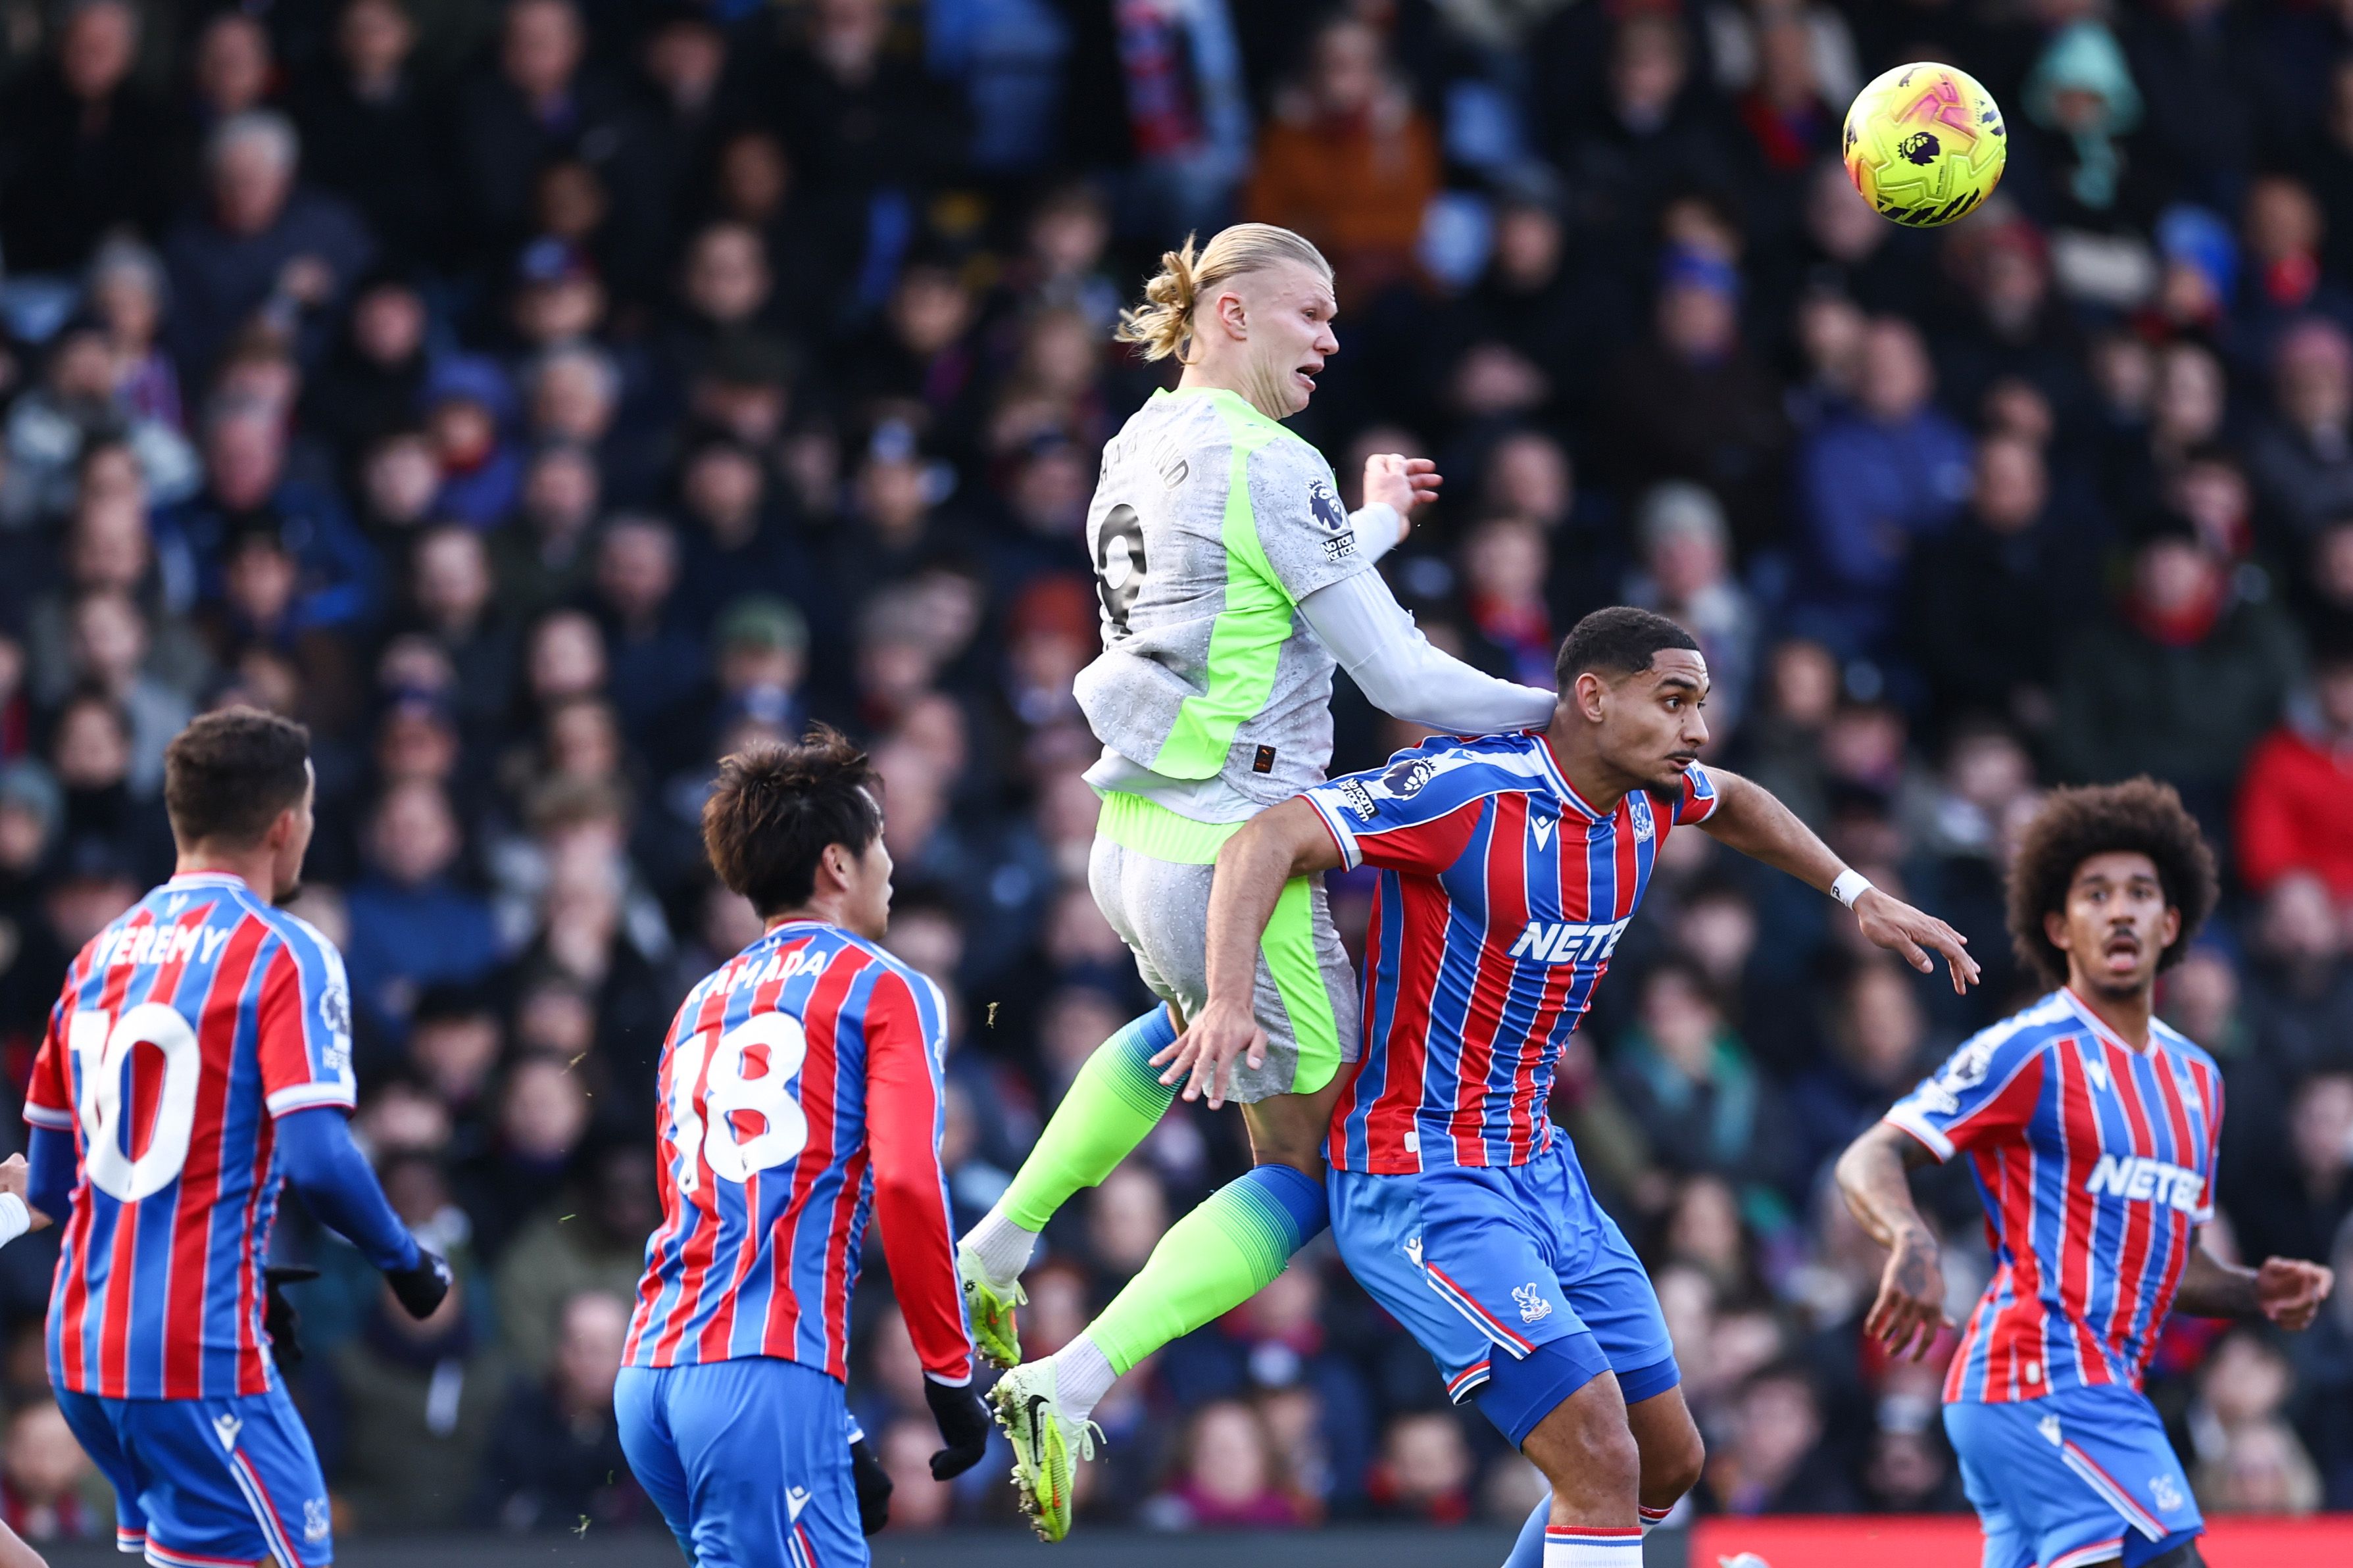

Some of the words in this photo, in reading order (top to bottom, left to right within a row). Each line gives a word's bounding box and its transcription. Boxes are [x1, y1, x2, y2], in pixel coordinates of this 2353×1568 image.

[1099, 431, 1189, 490] HAAND
[1098, 503, 1147, 640] 9
[1320, 541, 1337, 553] No
[1325, 550, 1341, 562] for
[1345, 789, 1370, 822] racism
[1347, 777, 1359, 789] No
[1353, 787, 1375, 814] room
[95, 923, 229, 968] YEREMY
[687, 950, 828, 1003] KAMADA
[68, 1002, 201, 1203] 10
[672, 1011, 808, 1194] 18
